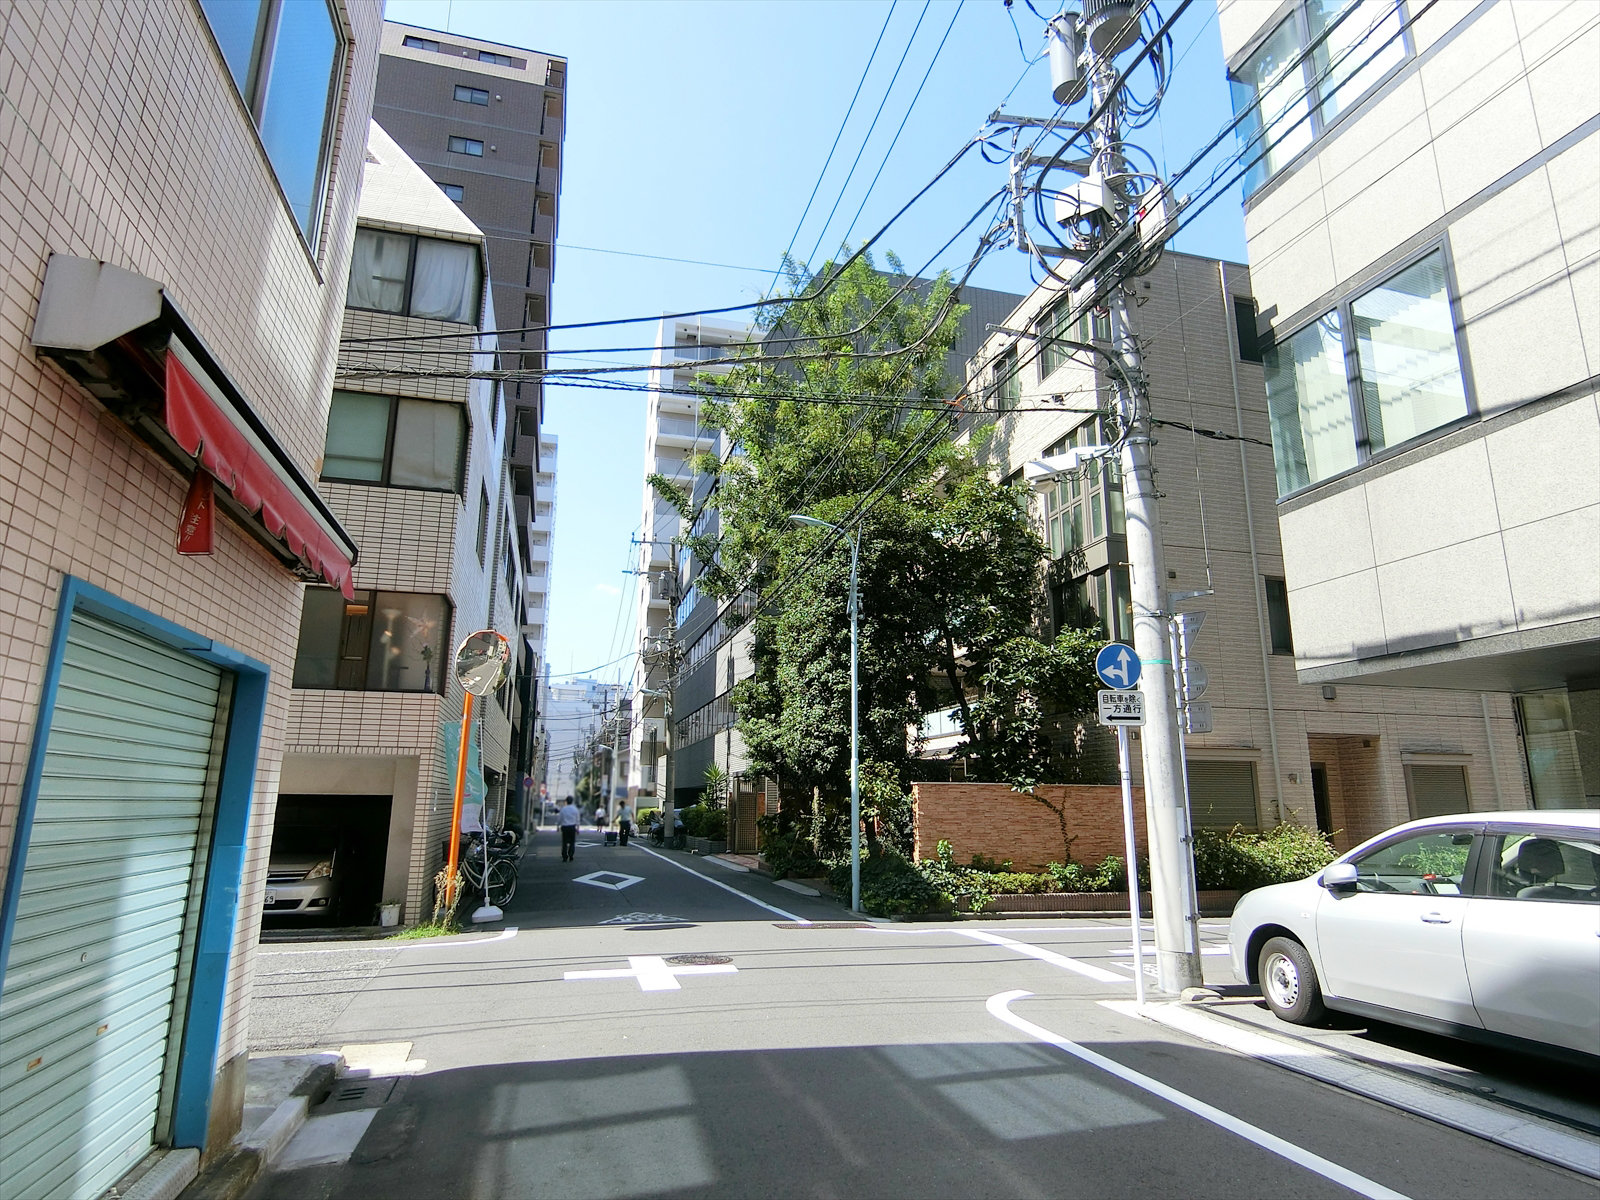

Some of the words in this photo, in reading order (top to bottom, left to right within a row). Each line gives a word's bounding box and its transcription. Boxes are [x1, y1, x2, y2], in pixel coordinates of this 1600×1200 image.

[1102, 694, 1140, 703] 自転車を除く
[1103, 704, 1141, 713] 一方通行
